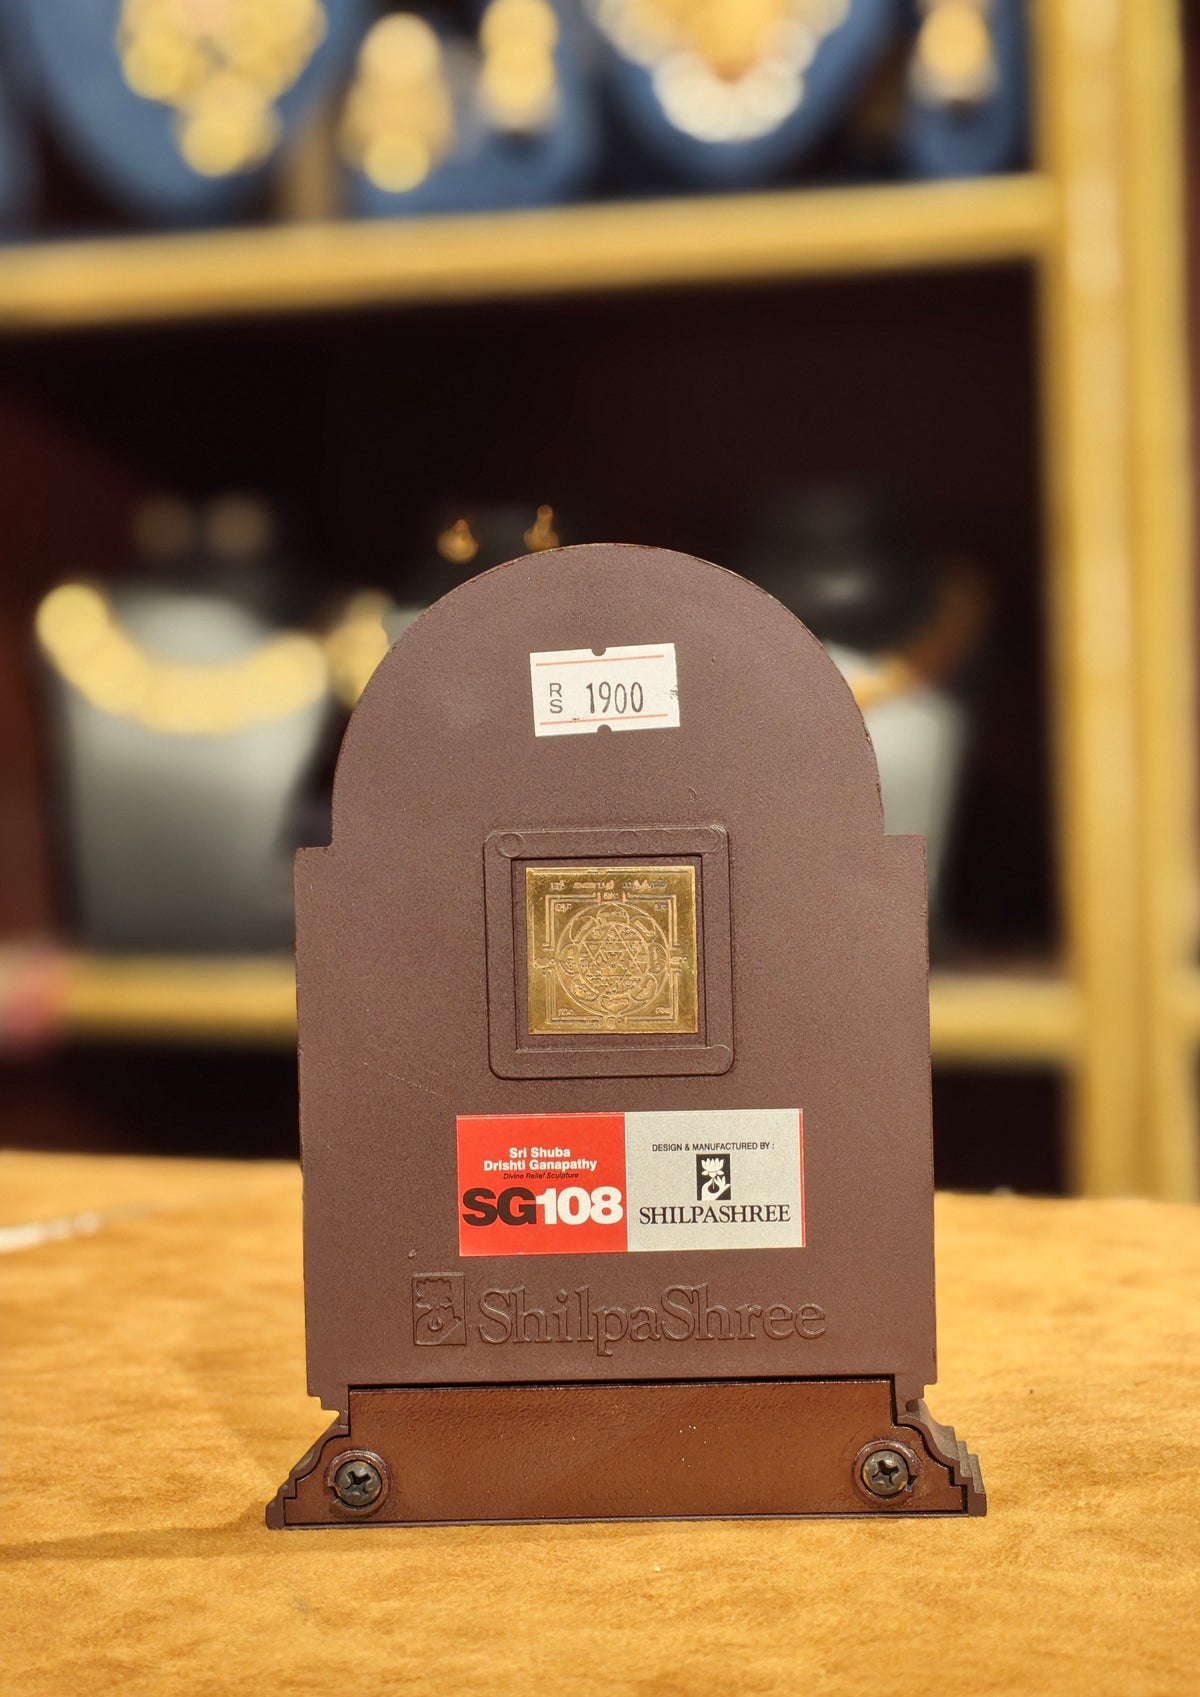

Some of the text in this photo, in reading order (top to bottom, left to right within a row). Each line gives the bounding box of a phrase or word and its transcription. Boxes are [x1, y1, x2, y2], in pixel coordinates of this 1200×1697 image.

[586, 681, 644, 714] 1900
[509, 1147, 571, 1158] Sri Shuba
[652, 1143, 682, 1152] DESIGN
[685, 1143, 690, 1151] &
[692, 1142, 758, 1151] MANUFACTURED
[483, 1159, 597, 1172] Drishti Ganapathy
[503, 1172, 580, 1180] Divine Relief Sculpture
[462, 1186, 624, 1227] SG108
[639, 1204, 791, 1225] SHILPASHREE
[478, 1283, 827, 1357] ShilpaShree
